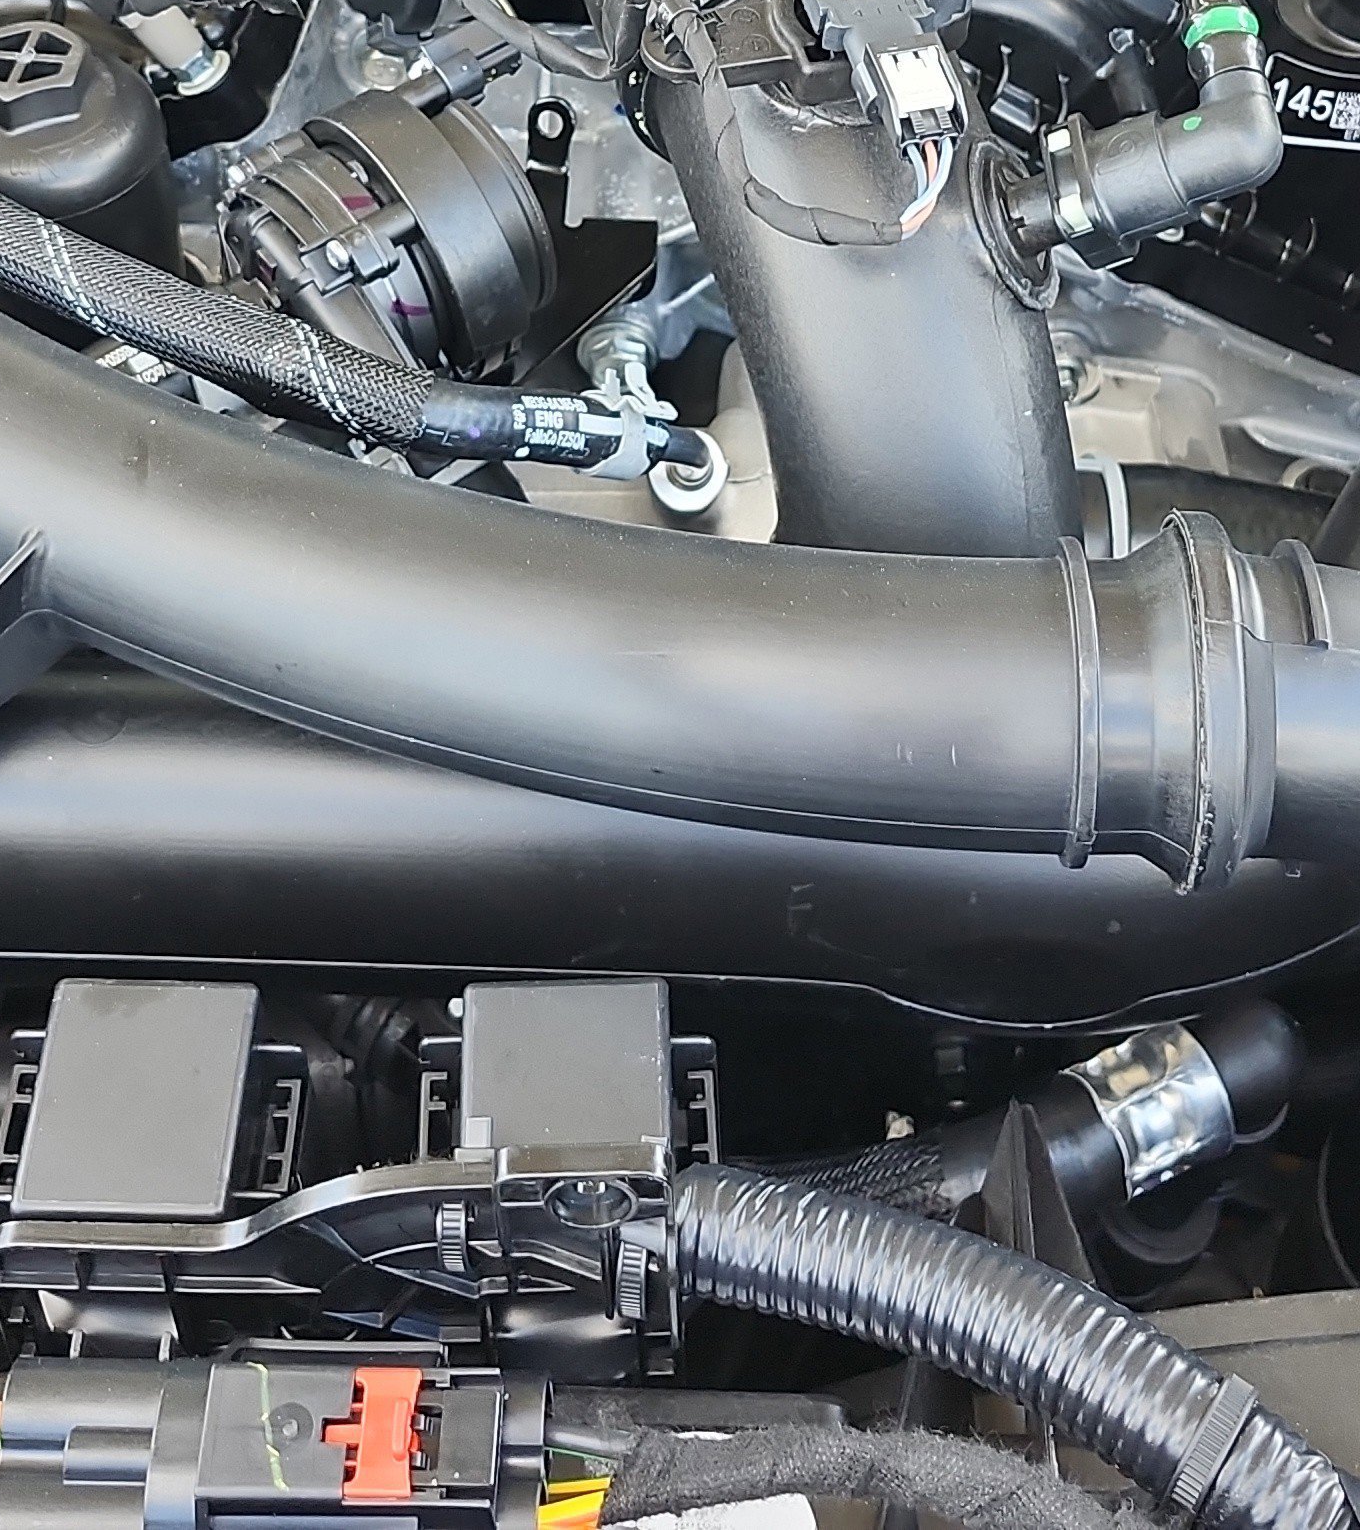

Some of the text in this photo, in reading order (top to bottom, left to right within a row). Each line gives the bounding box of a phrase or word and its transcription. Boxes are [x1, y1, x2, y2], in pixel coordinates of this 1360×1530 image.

[1272, 77, 1336, 122] 145
[535, 411, 564, 428] ENG
[525, 427, 557, 446] FoMoCo
